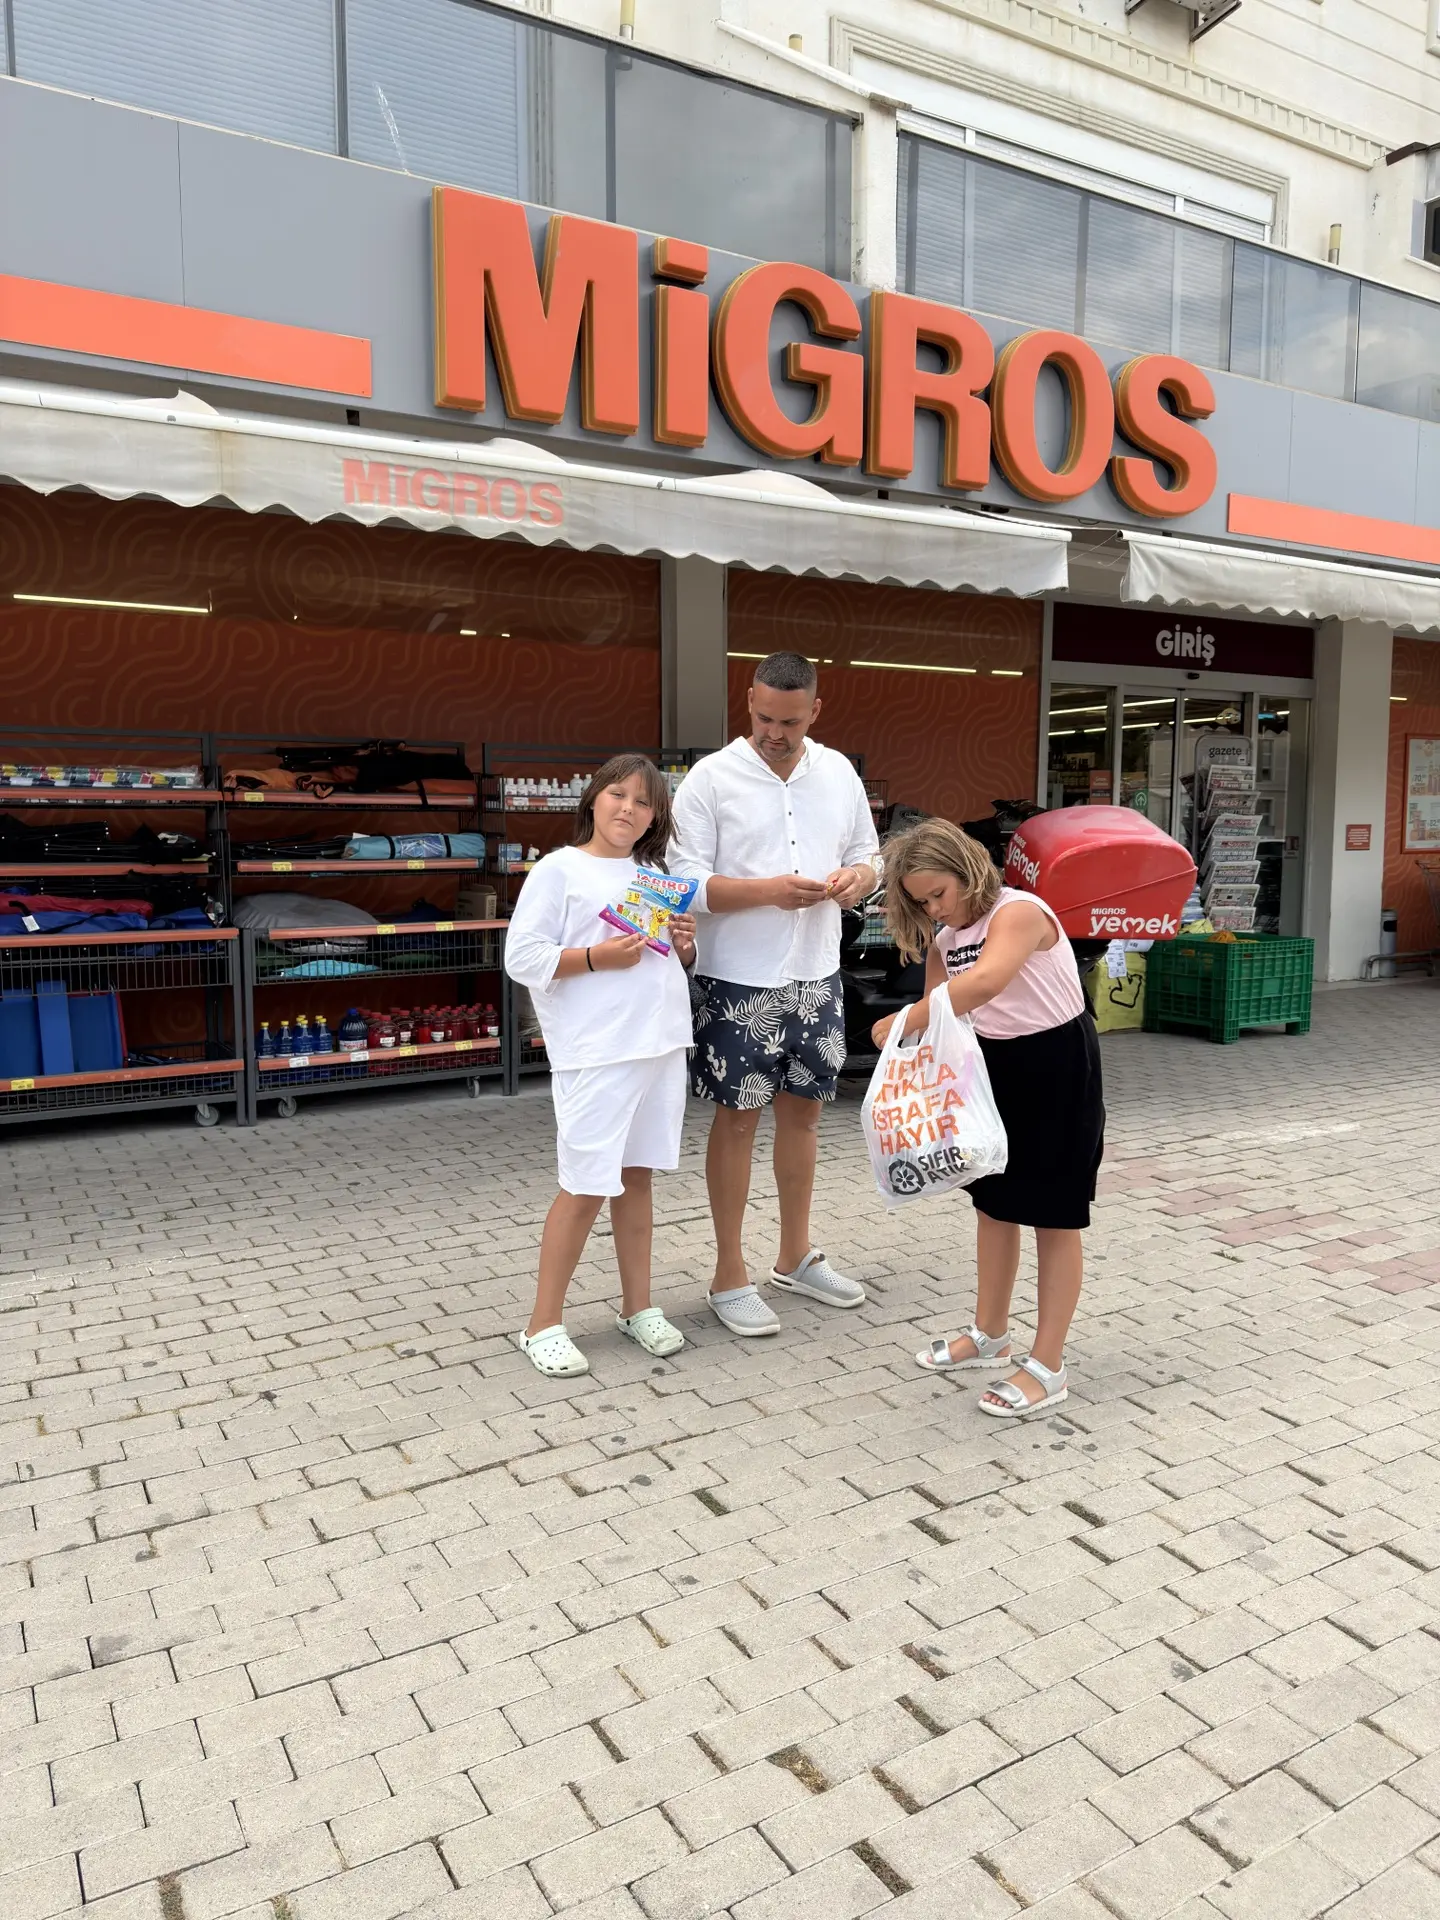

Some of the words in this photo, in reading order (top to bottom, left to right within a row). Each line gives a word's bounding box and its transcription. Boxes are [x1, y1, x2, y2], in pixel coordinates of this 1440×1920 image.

[1156, 623, 1216, 667] GİRİŞ
[1208, 746, 1242, 759] gazete
[1006, 841, 1040, 888] yemek
[1088, 913, 1177, 936] yemek
[880, 1114, 960, 1155] HAYIR
[918, 1146, 964, 1171] SIFIR
[927, 1162, 972, 1184] ATIK
